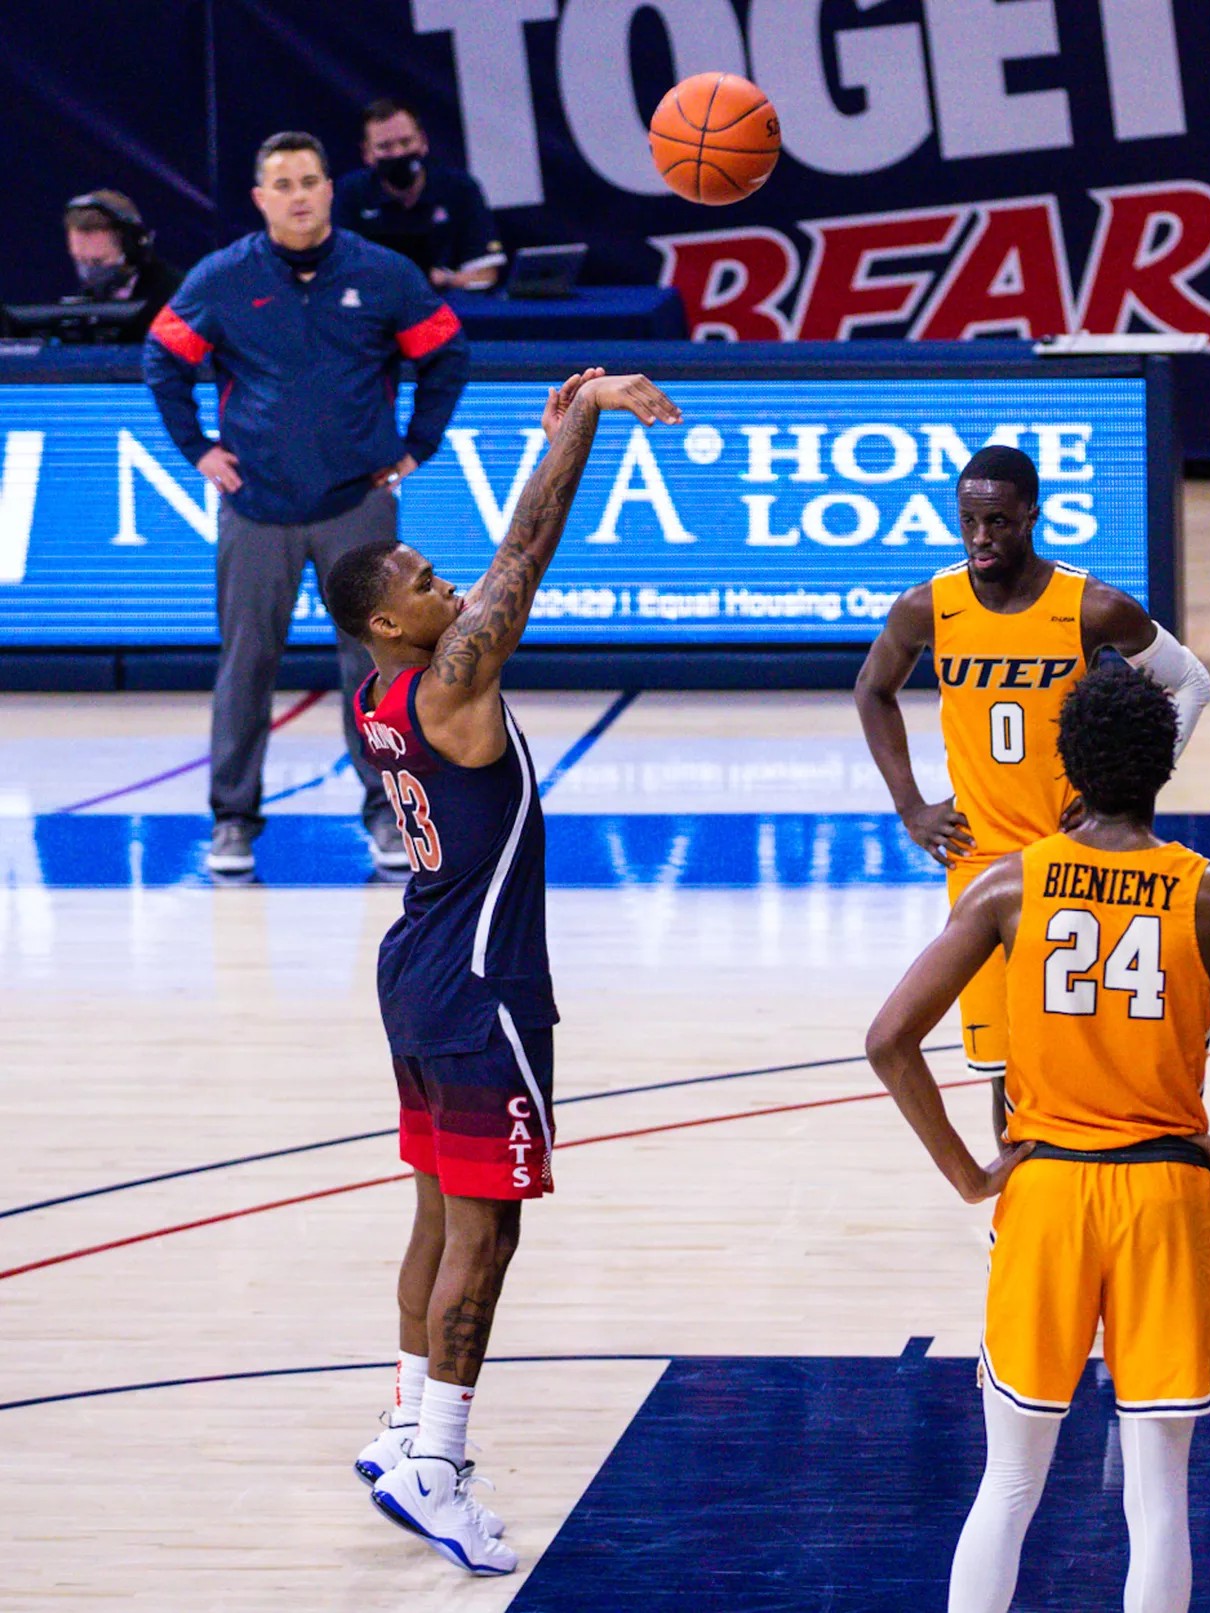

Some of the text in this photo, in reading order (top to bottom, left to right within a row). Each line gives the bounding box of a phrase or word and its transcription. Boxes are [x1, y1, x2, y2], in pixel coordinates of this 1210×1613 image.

[740, 422, 1095, 484] HOME
[110, 427, 697, 547] NVA
[742, 494, 1098, 546] LOAS
[637, 587, 720, 620] Equal
[724, 587, 843, 621] Housing
[939, 655, 1079, 689] UTEP
[989, 701, 1026, 765] 0
[1043, 862, 1180, 911] BIENIEMY
[1044, 908, 1167, 1021] 24
[507, 1096, 532, 1189] CATS
